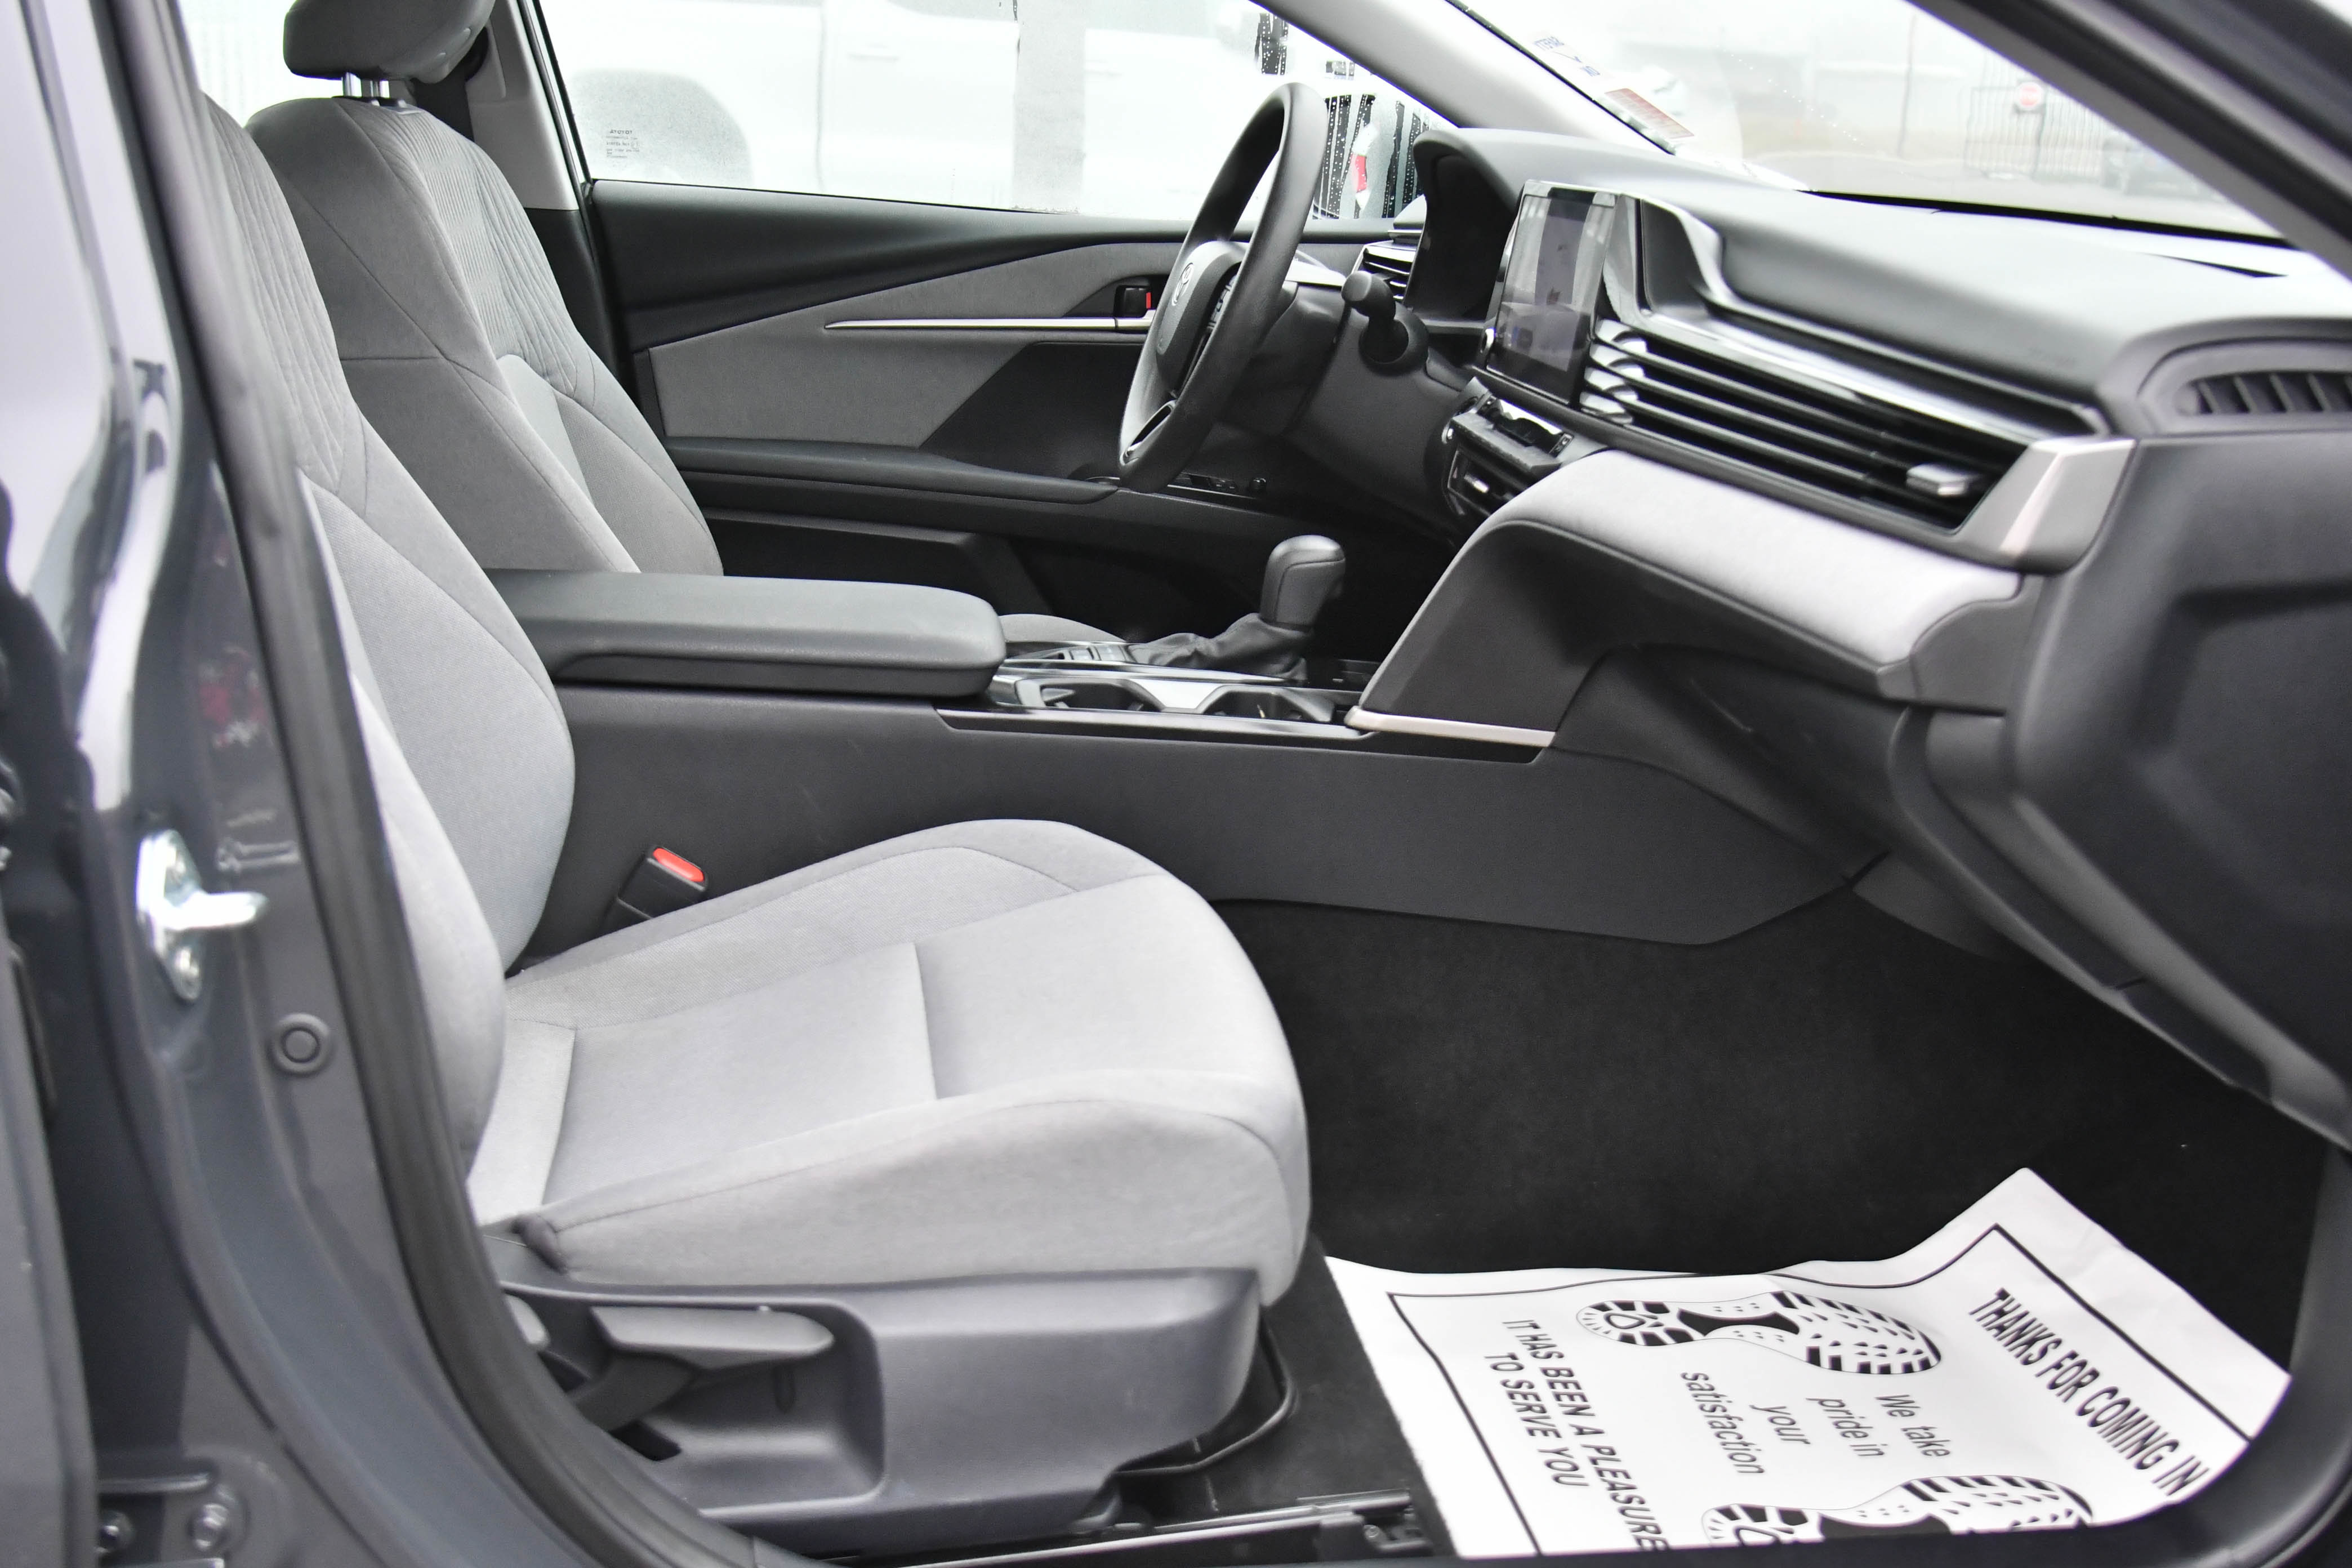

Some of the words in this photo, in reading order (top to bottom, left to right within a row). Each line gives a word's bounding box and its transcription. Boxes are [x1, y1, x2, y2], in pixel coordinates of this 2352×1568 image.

[1502, 1320, 1542, 1330] IT
[1516, 1333, 1565, 1360] HAS
[1485, 1352, 1525, 1372] TO
[1500, 1379, 1562, 1438] SERVE
[1540, 1367, 1596, 1416] BEEN
[1969, 1288, 2063, 1366] THANKS
[2035, 1350, 2100, 1403] FOR
[2075, 1386, 2180, 1470] COMING
[2153, 1455, 2210, 1496] IN
[1569, 1423, 1605, 1436] A
[1681, 1372, 1765, 1474] satisfaction
[1749, 1405, 1811, 1445] your
[1806, 1398, 1873, 1439] pride
[1850, 1443, 1888, 1456] in
[1875, 1394, 1921, 1418] We
[1901, 1426, 1951, 1457] take
[1538, 1447, 1589, 1487] YOU
[1581, 1444, 1670, 1550] PLEASURE
